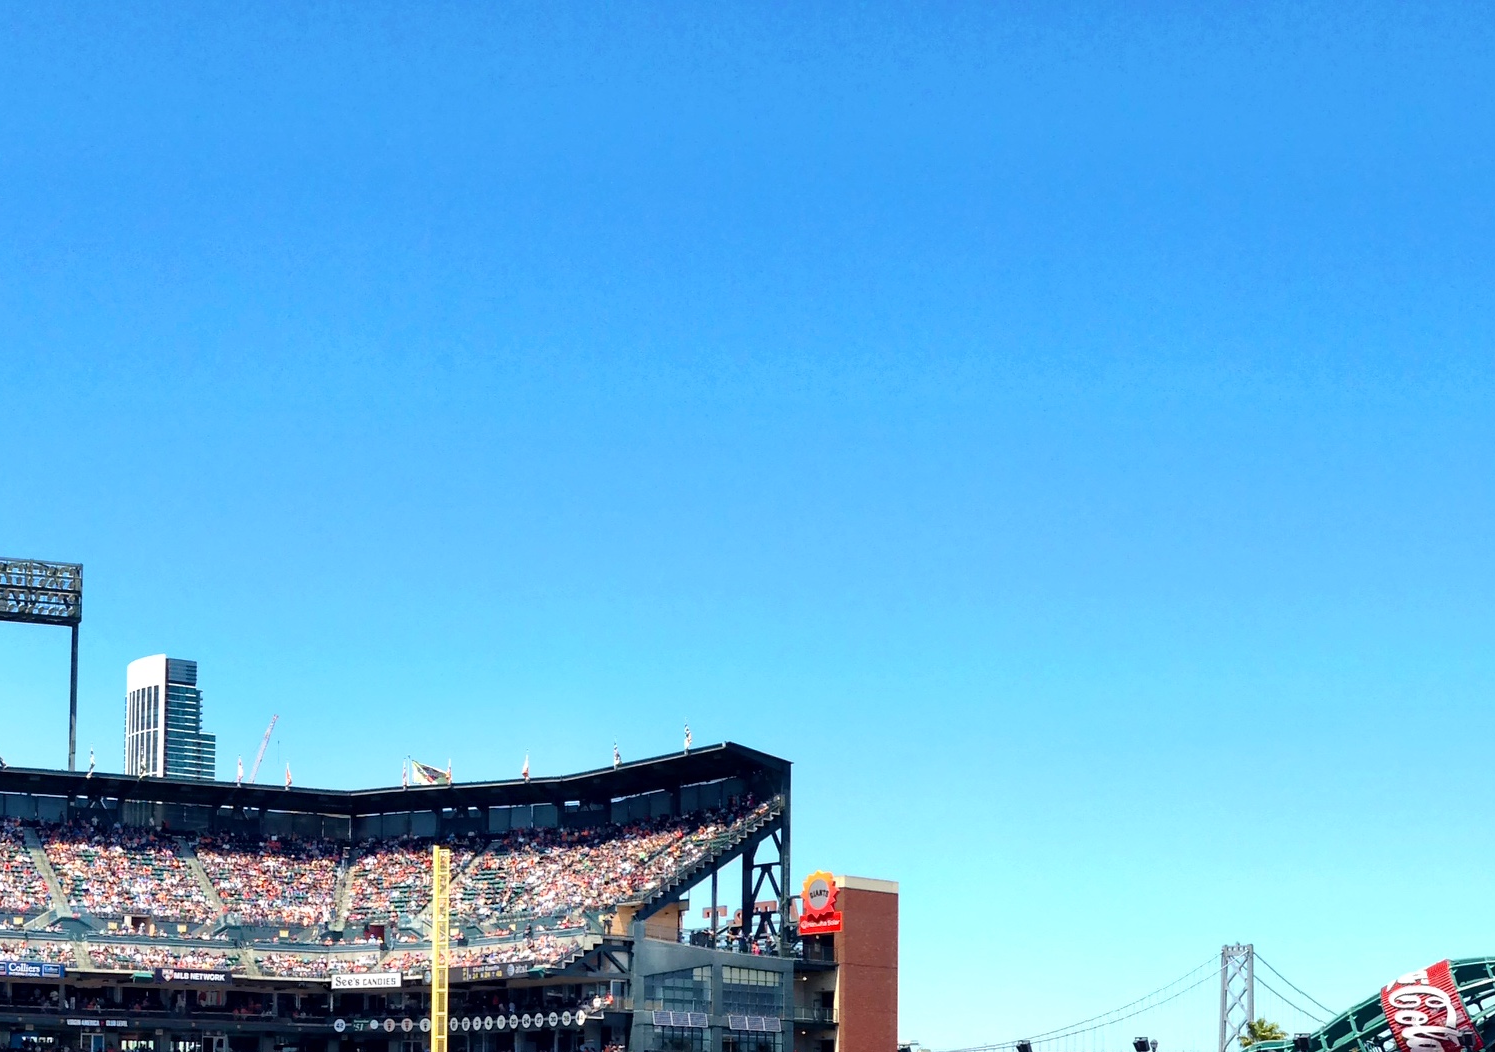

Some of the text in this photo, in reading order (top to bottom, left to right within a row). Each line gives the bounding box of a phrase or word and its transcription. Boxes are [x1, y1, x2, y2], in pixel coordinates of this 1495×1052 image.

[809, 889, 829, 899] GIANTS
[8, 962, 41, 973] Colliers
[174, 972, 226, 982] MLB NETWORK
[335, 976, 396, 987] See's CANDIES
